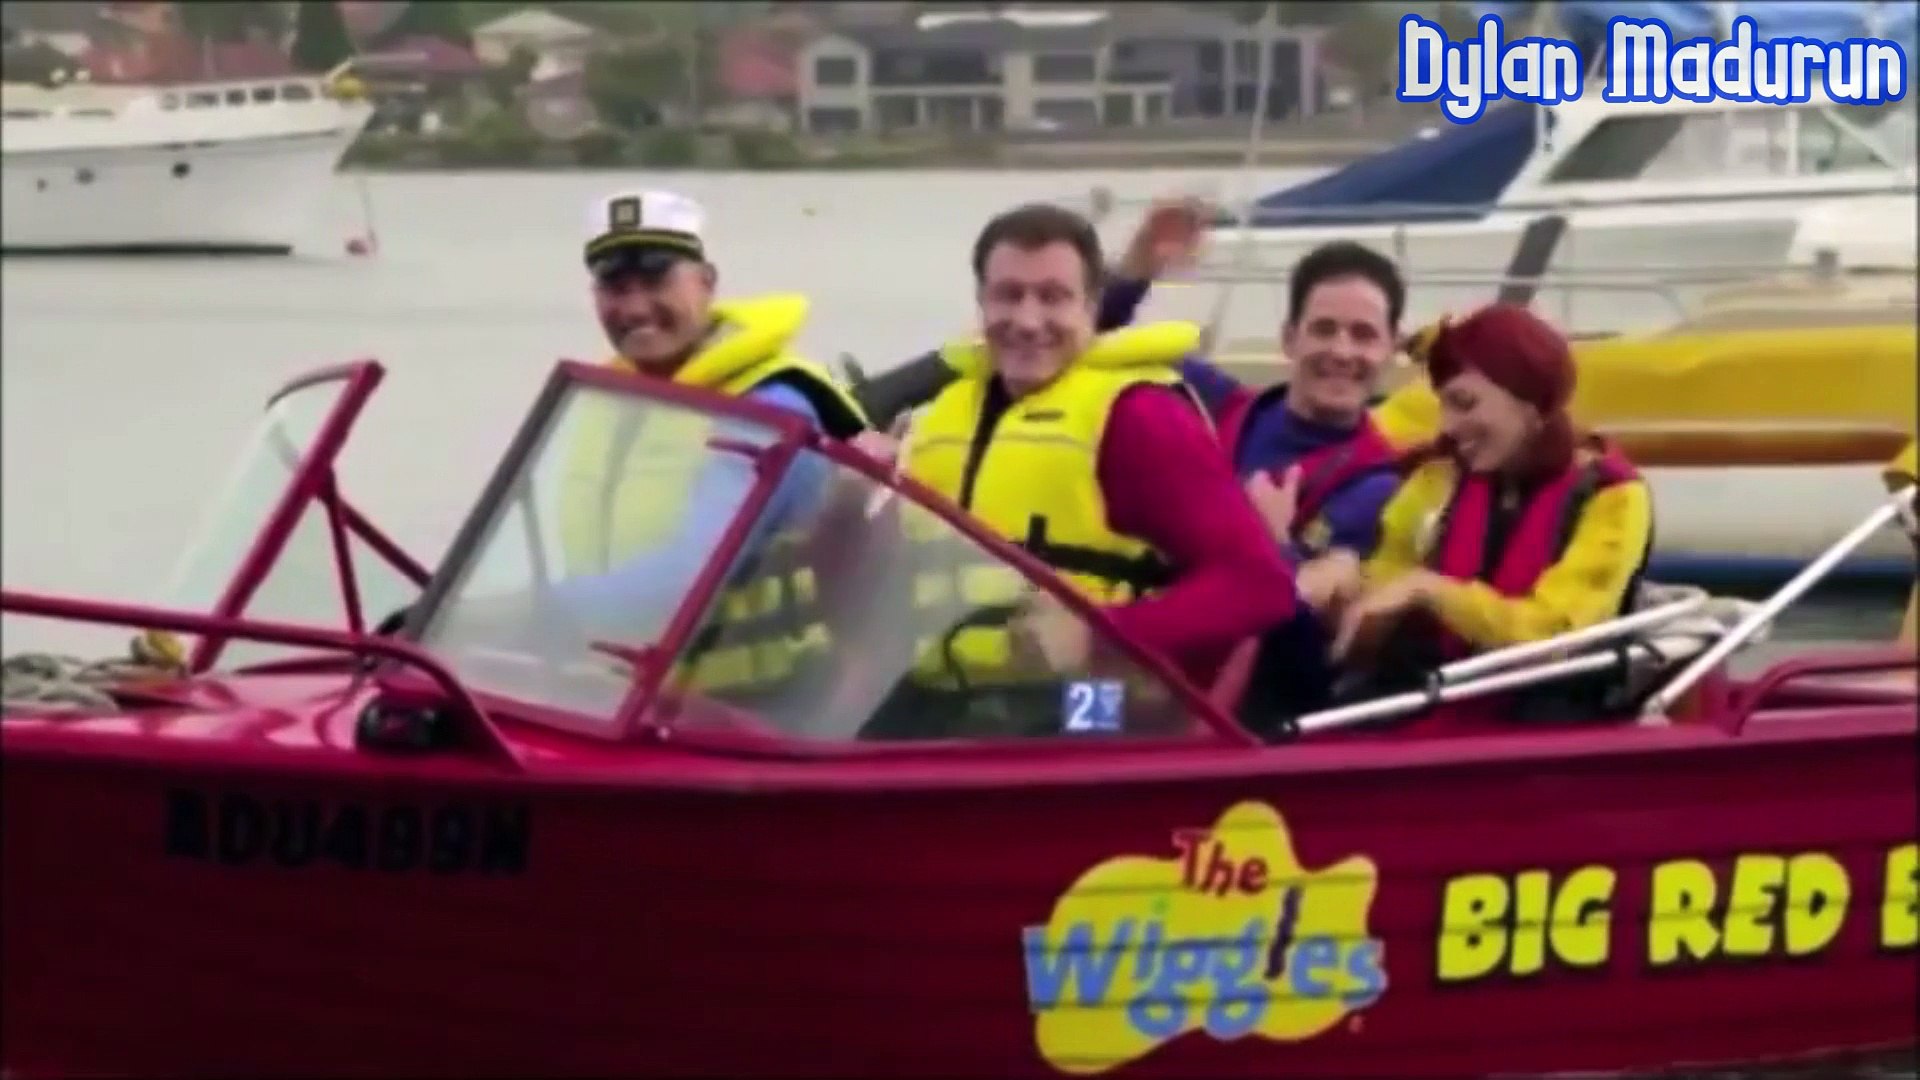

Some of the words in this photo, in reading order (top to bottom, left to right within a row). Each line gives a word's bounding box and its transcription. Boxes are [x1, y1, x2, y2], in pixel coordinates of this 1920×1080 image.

[1067, 682, 1095, 730] 2
[1172, 828, 1269, 897] The
[1022, 884, 1388, 1042] Wiggles
[1436, 865, 1616, 981] BIG
[1648, 852, 1851, 966] RED
